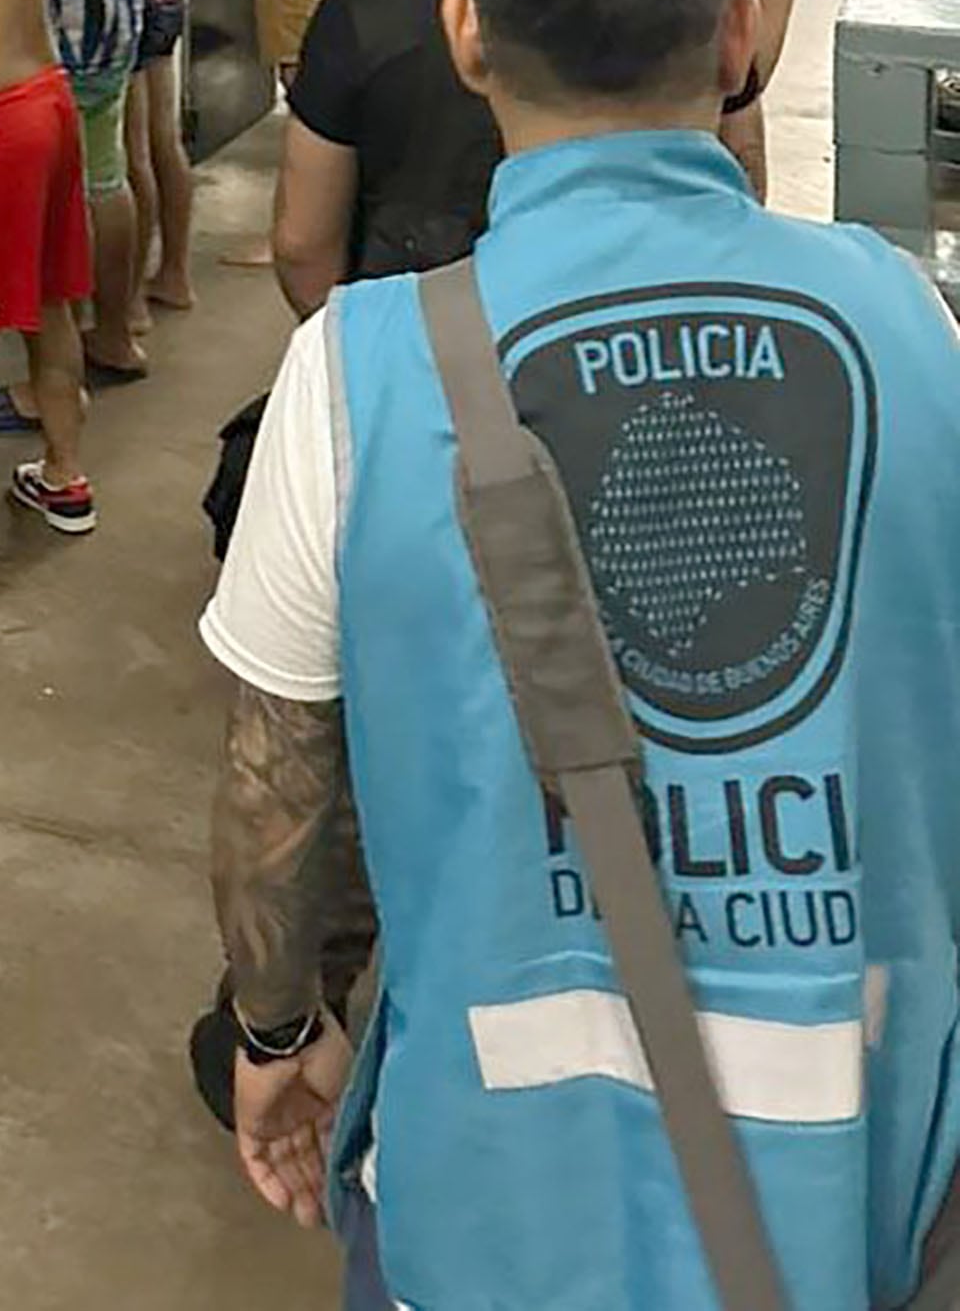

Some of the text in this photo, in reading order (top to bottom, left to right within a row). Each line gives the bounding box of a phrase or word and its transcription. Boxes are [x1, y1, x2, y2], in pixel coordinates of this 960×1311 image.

[575, 325, 785, 393] POLICIA
[551, 868, 858, 948] D A CIUD
